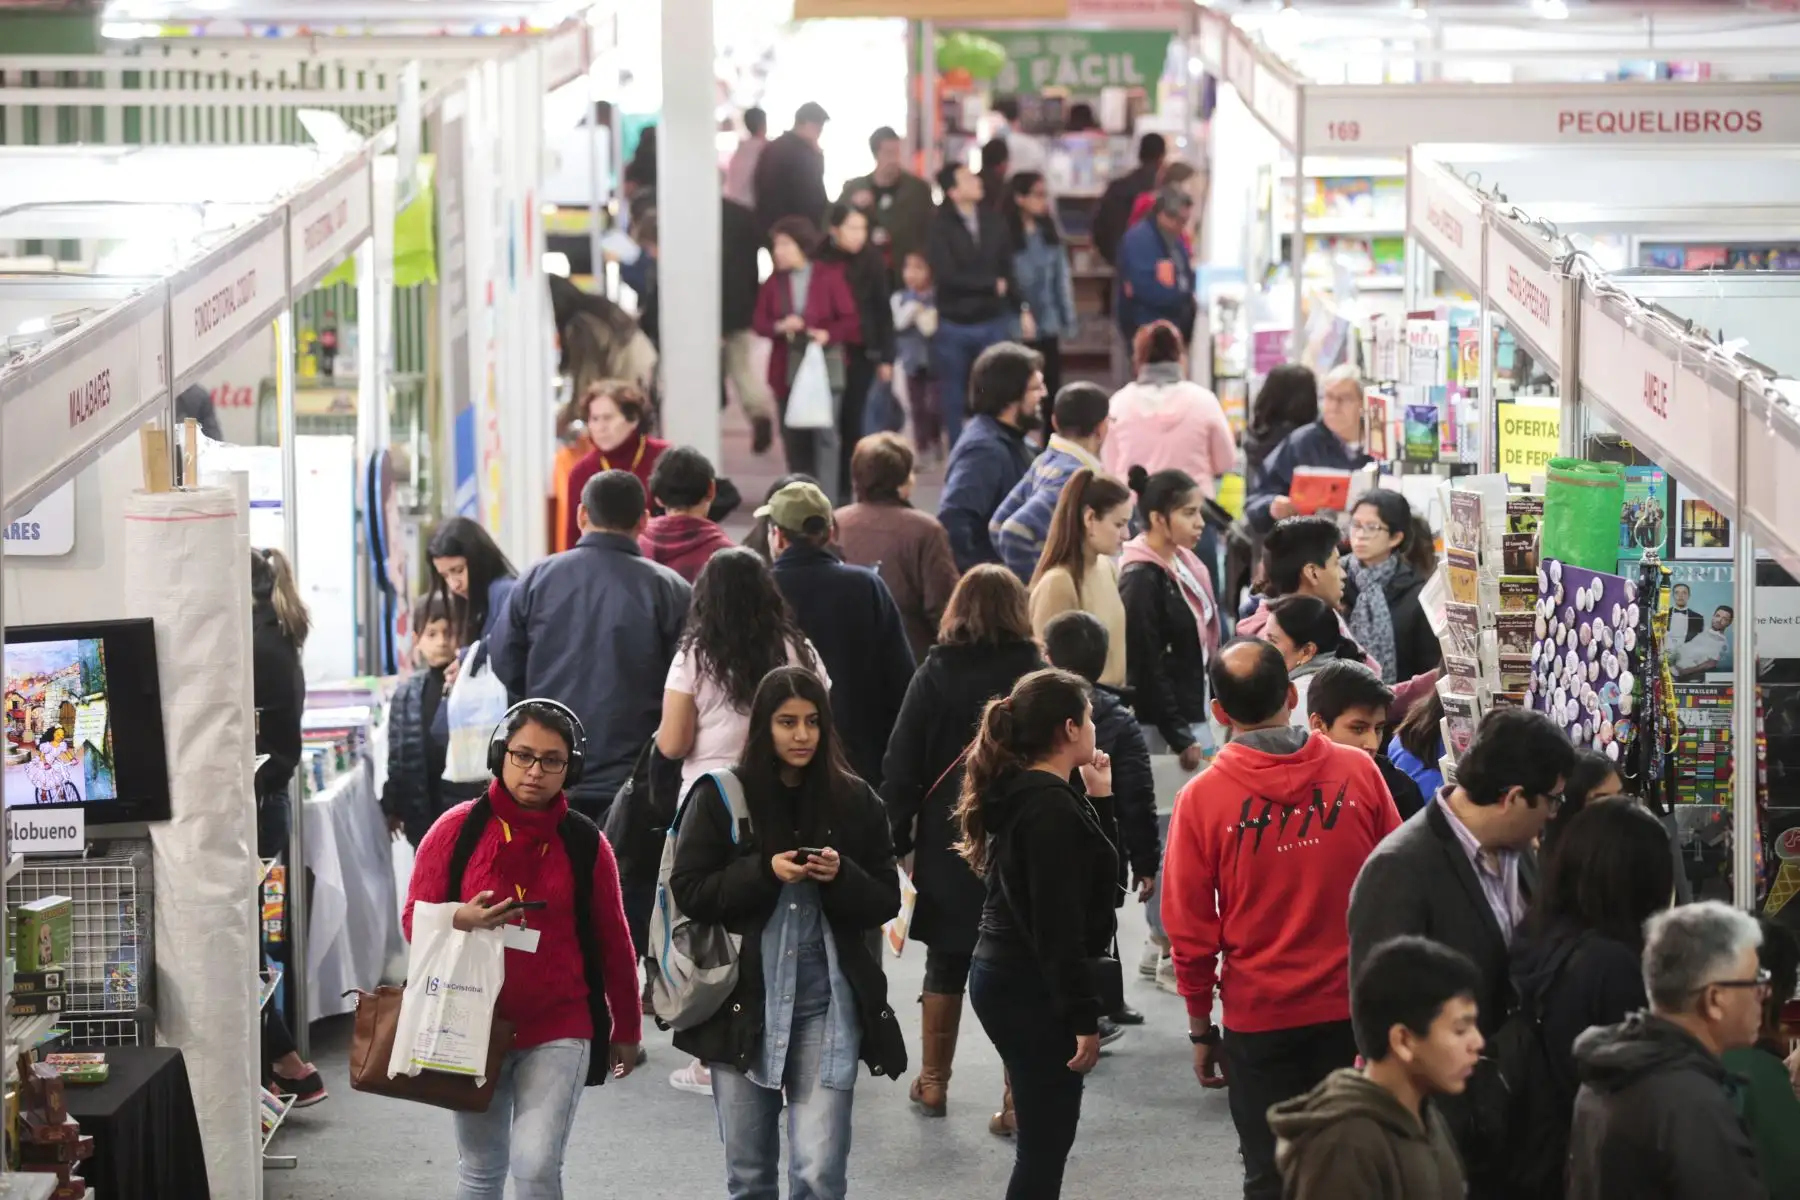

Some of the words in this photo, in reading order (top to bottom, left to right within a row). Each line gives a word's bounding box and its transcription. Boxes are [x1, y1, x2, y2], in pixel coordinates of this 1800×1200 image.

[1327, 121, 1361, 142] 169
[1558, 109, 1763, 134] PEQUELIBROS
[69, 367, 111, 429] MALABARES
[1506, 449, 1523, 464] DE
[1526, 450, 1559, 466] FER
[1769, 616, 1792, 625] Next
[1226, 800, 1356, 833] HUNTINGTON
